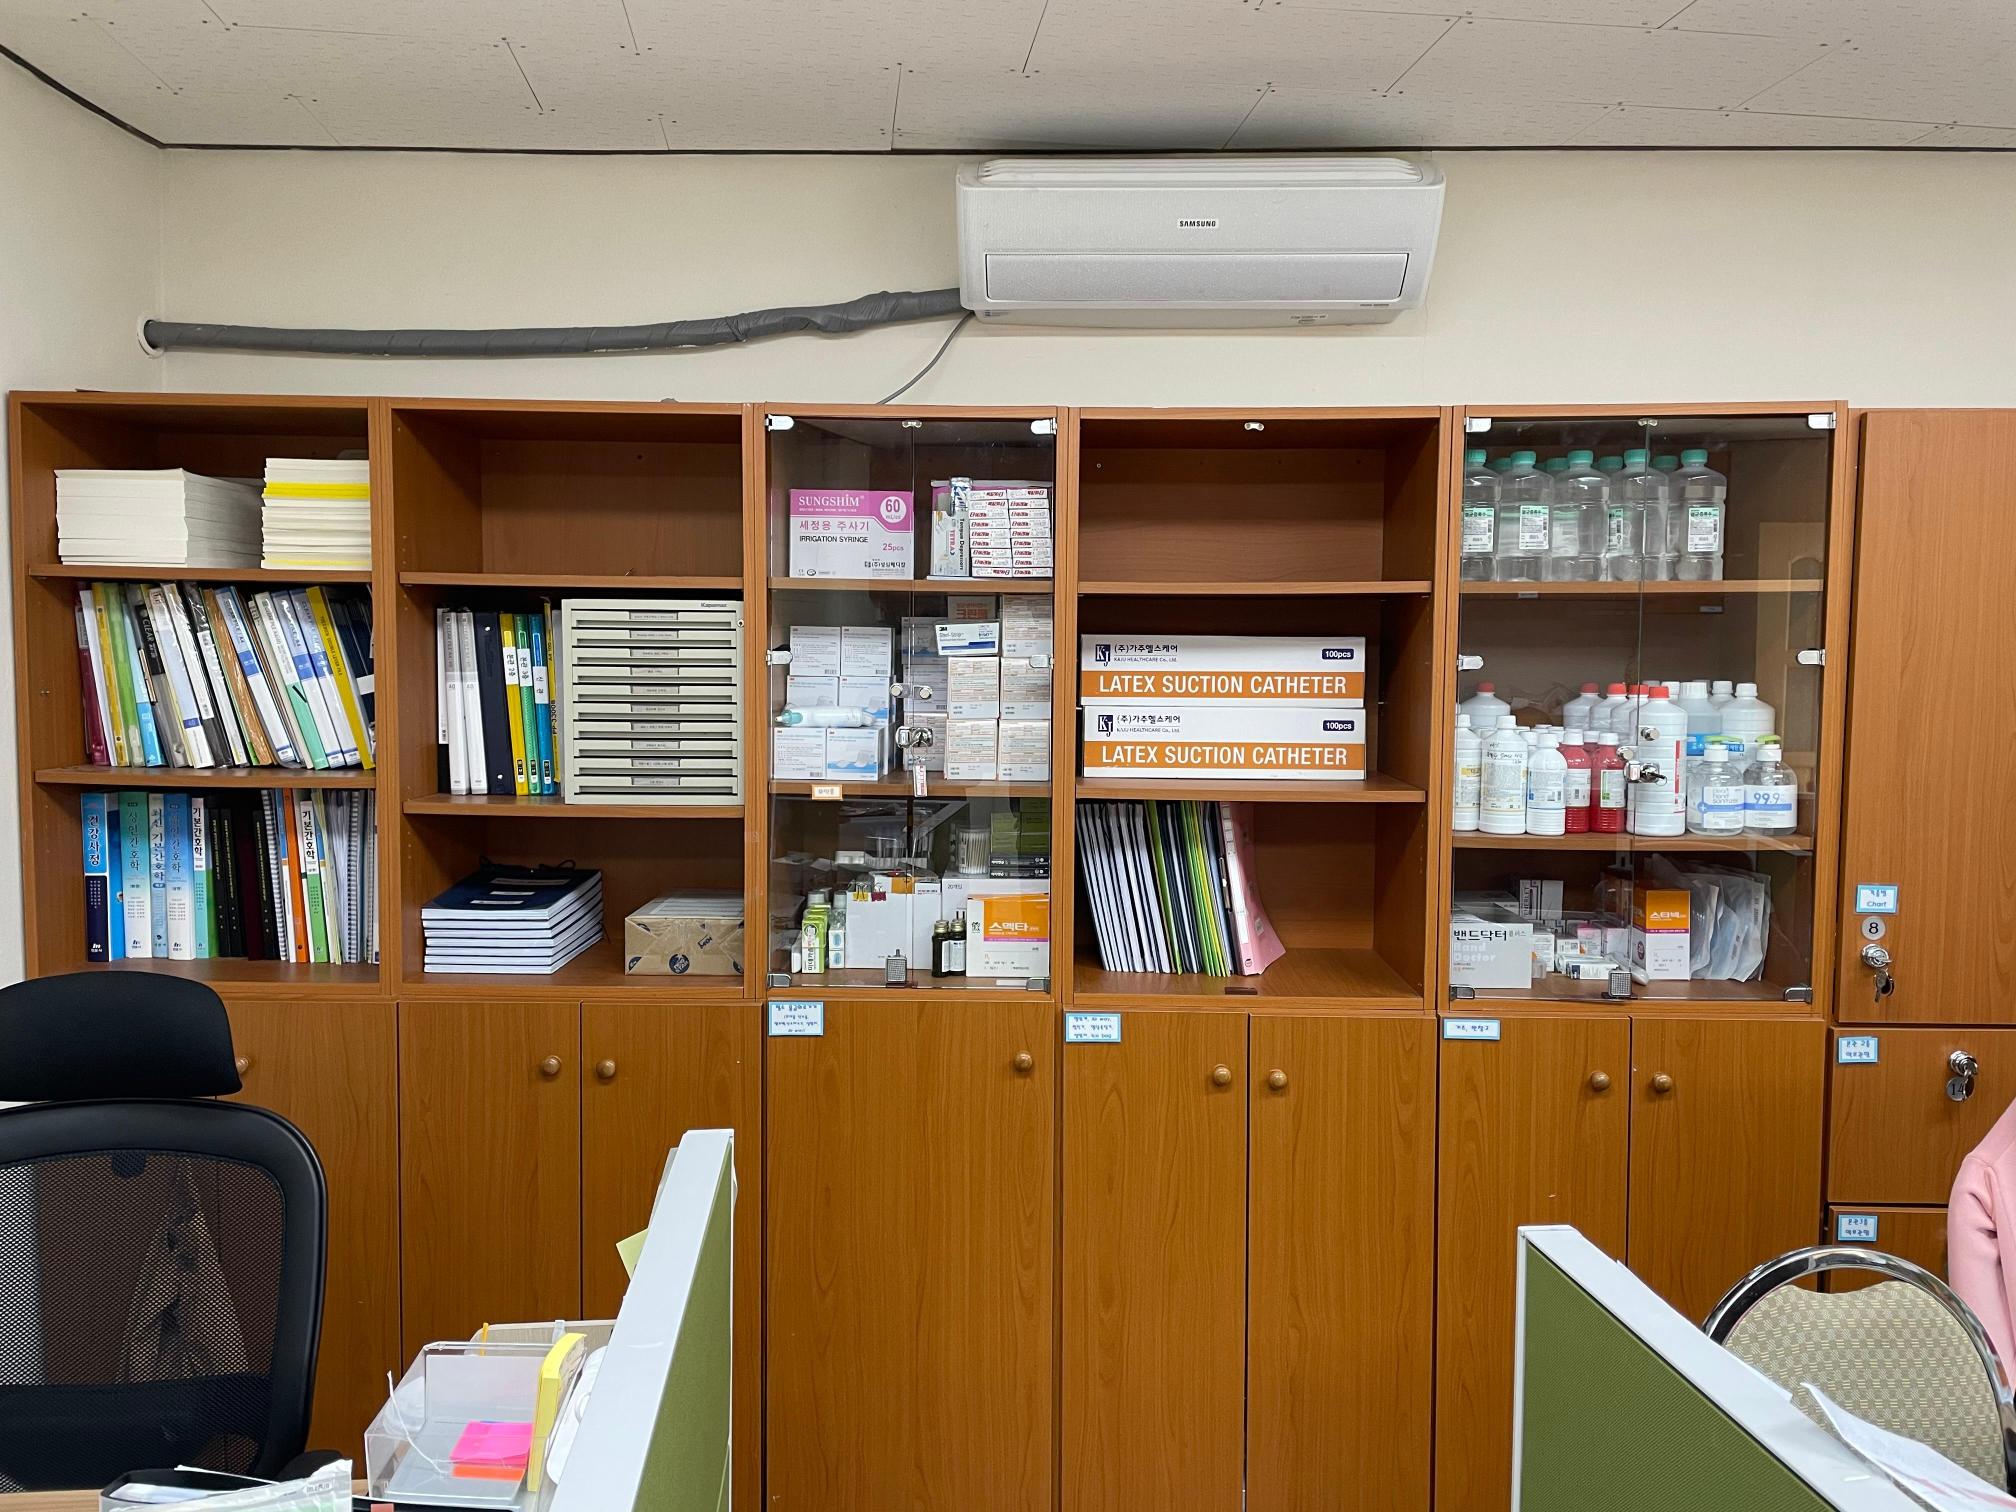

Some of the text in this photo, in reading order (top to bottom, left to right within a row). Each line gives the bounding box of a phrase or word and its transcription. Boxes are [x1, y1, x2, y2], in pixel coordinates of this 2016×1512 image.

[885, 498, 901, 513] 60
[799, 520, 869, 532] 세정용 주사기
[799, 535, 837, 543] IRRIGATION
[882, 543, 905, 551] 25pcs
[1114, 643, 1178, 654] (주)가주헬스케어
[1325, 650, 1351, 659] 100pcs
[1099, 675, 1347, 695] LATEX SUCTION CATHETER
[1116, 714, 1181, 725] (주)가주헬스케어
[1326, 721, 1352, 731] 100pcs
[1102, 745, 1348, 766] LATEX SUCTION CATHETER
[193, 807, 203, 857] 기본간호학
[302, 810, 316, 860] 기본간호학
[88, 815, 100, 867] 건강사정
[128, 811, 141, 871] 성인간호학
[151, 833, 166, 881] 기본간호학
[988, 922, 1028, 932] 스멕타
[1868, 922, 1879, 934] 8
[1453, 930, 1507, 941] 밴드닥터
[1453, 952, 1497, 962] Doctor
[1951, 1083, 1964, 1096] 14
